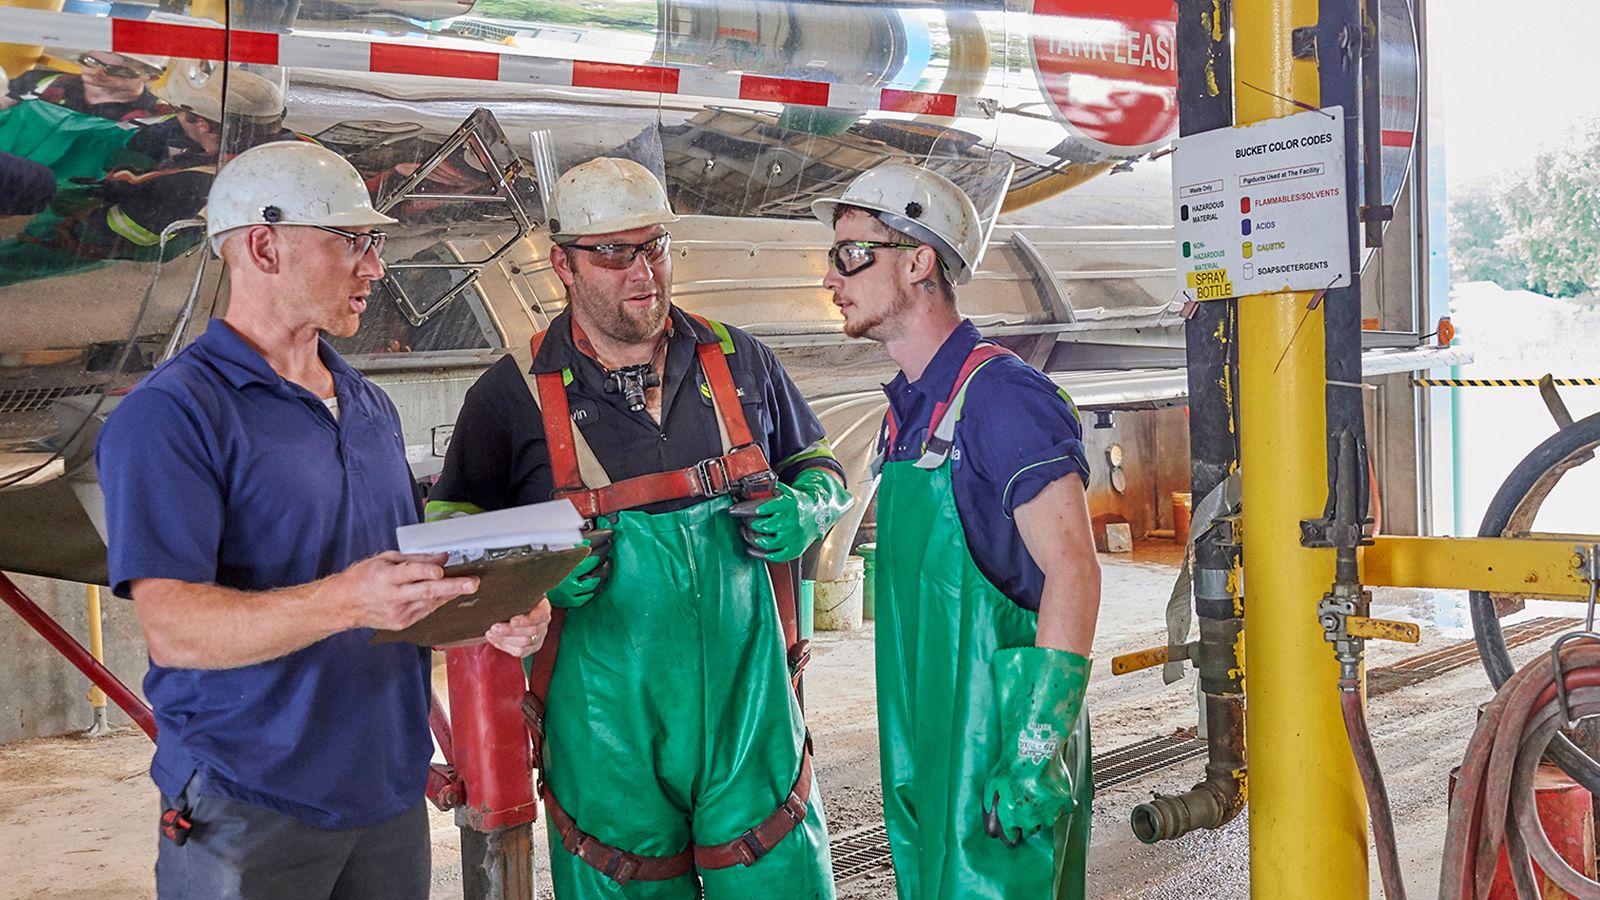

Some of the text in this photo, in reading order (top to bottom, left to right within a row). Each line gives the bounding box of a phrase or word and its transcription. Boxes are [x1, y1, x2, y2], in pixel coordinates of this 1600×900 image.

[1235, 133, 1333, 158] BUCKET COLOR CODES
[1243, 176, 1266, 184] Products
[1299, 167, 1320, 175] Facility
[1254, 188, 1340, 207] FLAMMABLES/SOLVENTS
[1192, 201, 1225, 212] HAZARDOUS
[1192, 213, 1219, 223] MATERIAL
[1255, 221, 1276, 230] ACIDS
[1256, 242, 1285, 252] CAUSTIC
[1193, 250, 1225, 260] HAZARDOUS
[1194, 262, 1220, 271] MATERIAL
[1257, 261, 1329, 275] SOAPS/DETERGENTS
[1195, 271, 1227, 286] SPRAY
[1197, 283, 1232, 298] BOTTLE
